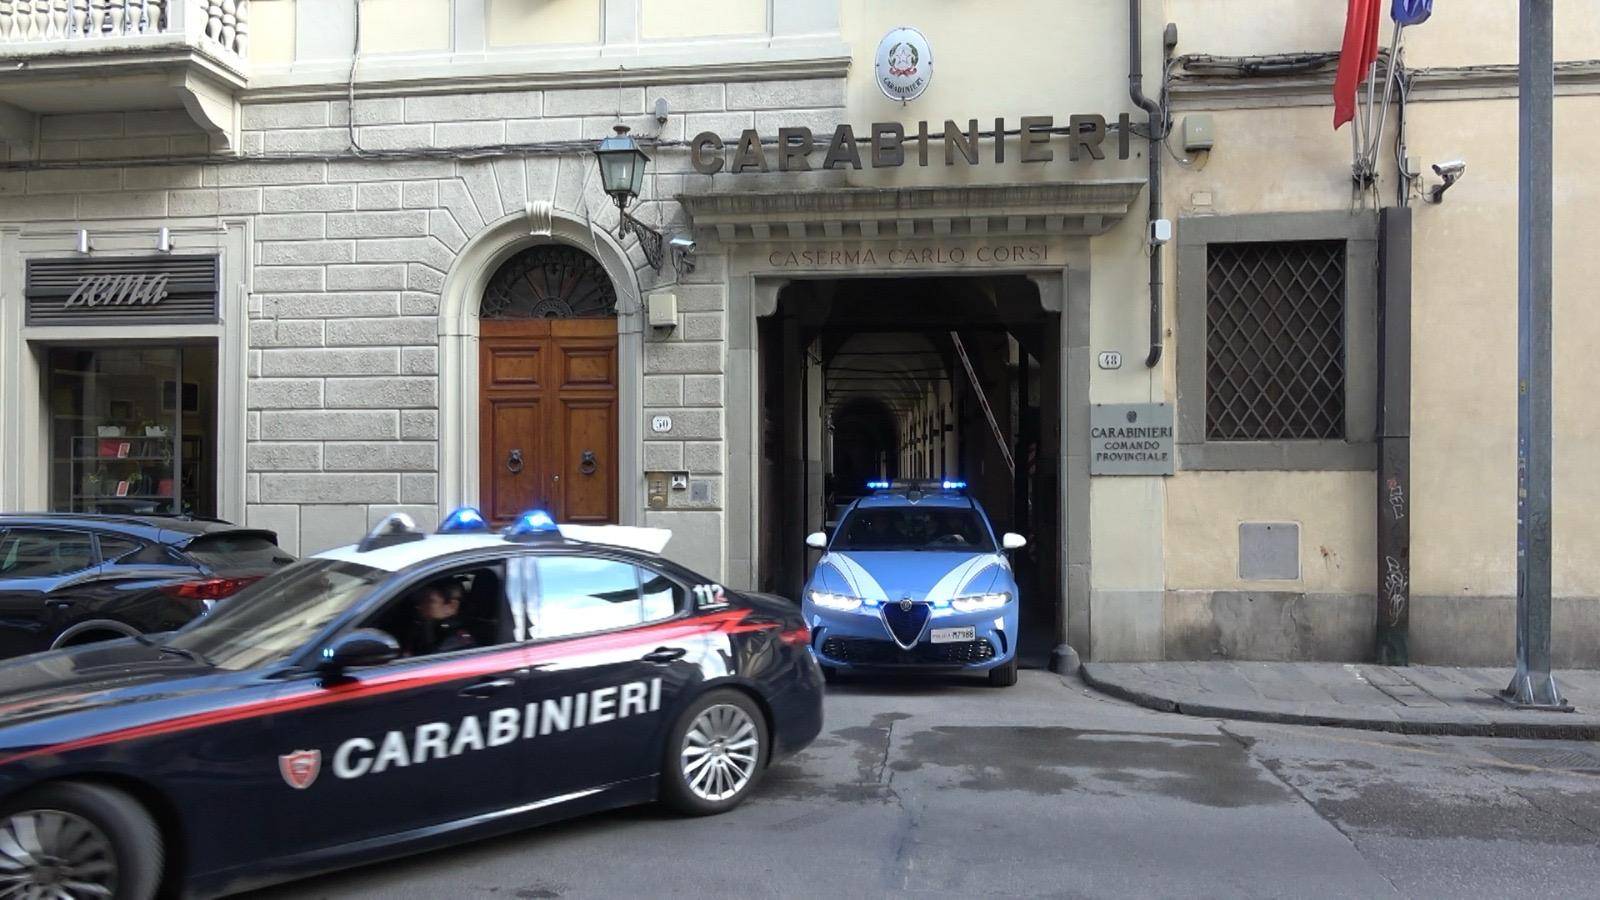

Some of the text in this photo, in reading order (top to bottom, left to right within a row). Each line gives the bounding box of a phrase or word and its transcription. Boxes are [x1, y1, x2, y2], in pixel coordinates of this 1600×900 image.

[883, 78, 923, 93] CARABINIERI
[691, 113, 1129, 175] CARABINIERI
[769, 246, 1049, 266] CASERMA CARLO CORSI
[1104, 354, 1117, 366] 48
[656, 419, 670, 430] 50
[1091, 426, 1172, 438] CARABINIERI
[1104, 441, 1160, 450] COMANDO
[1096, 452, 1168, 462] PROVINCIALE
[692, 584, 728, 605] 112
[334, 678, 662, 779] CARABINIERI
